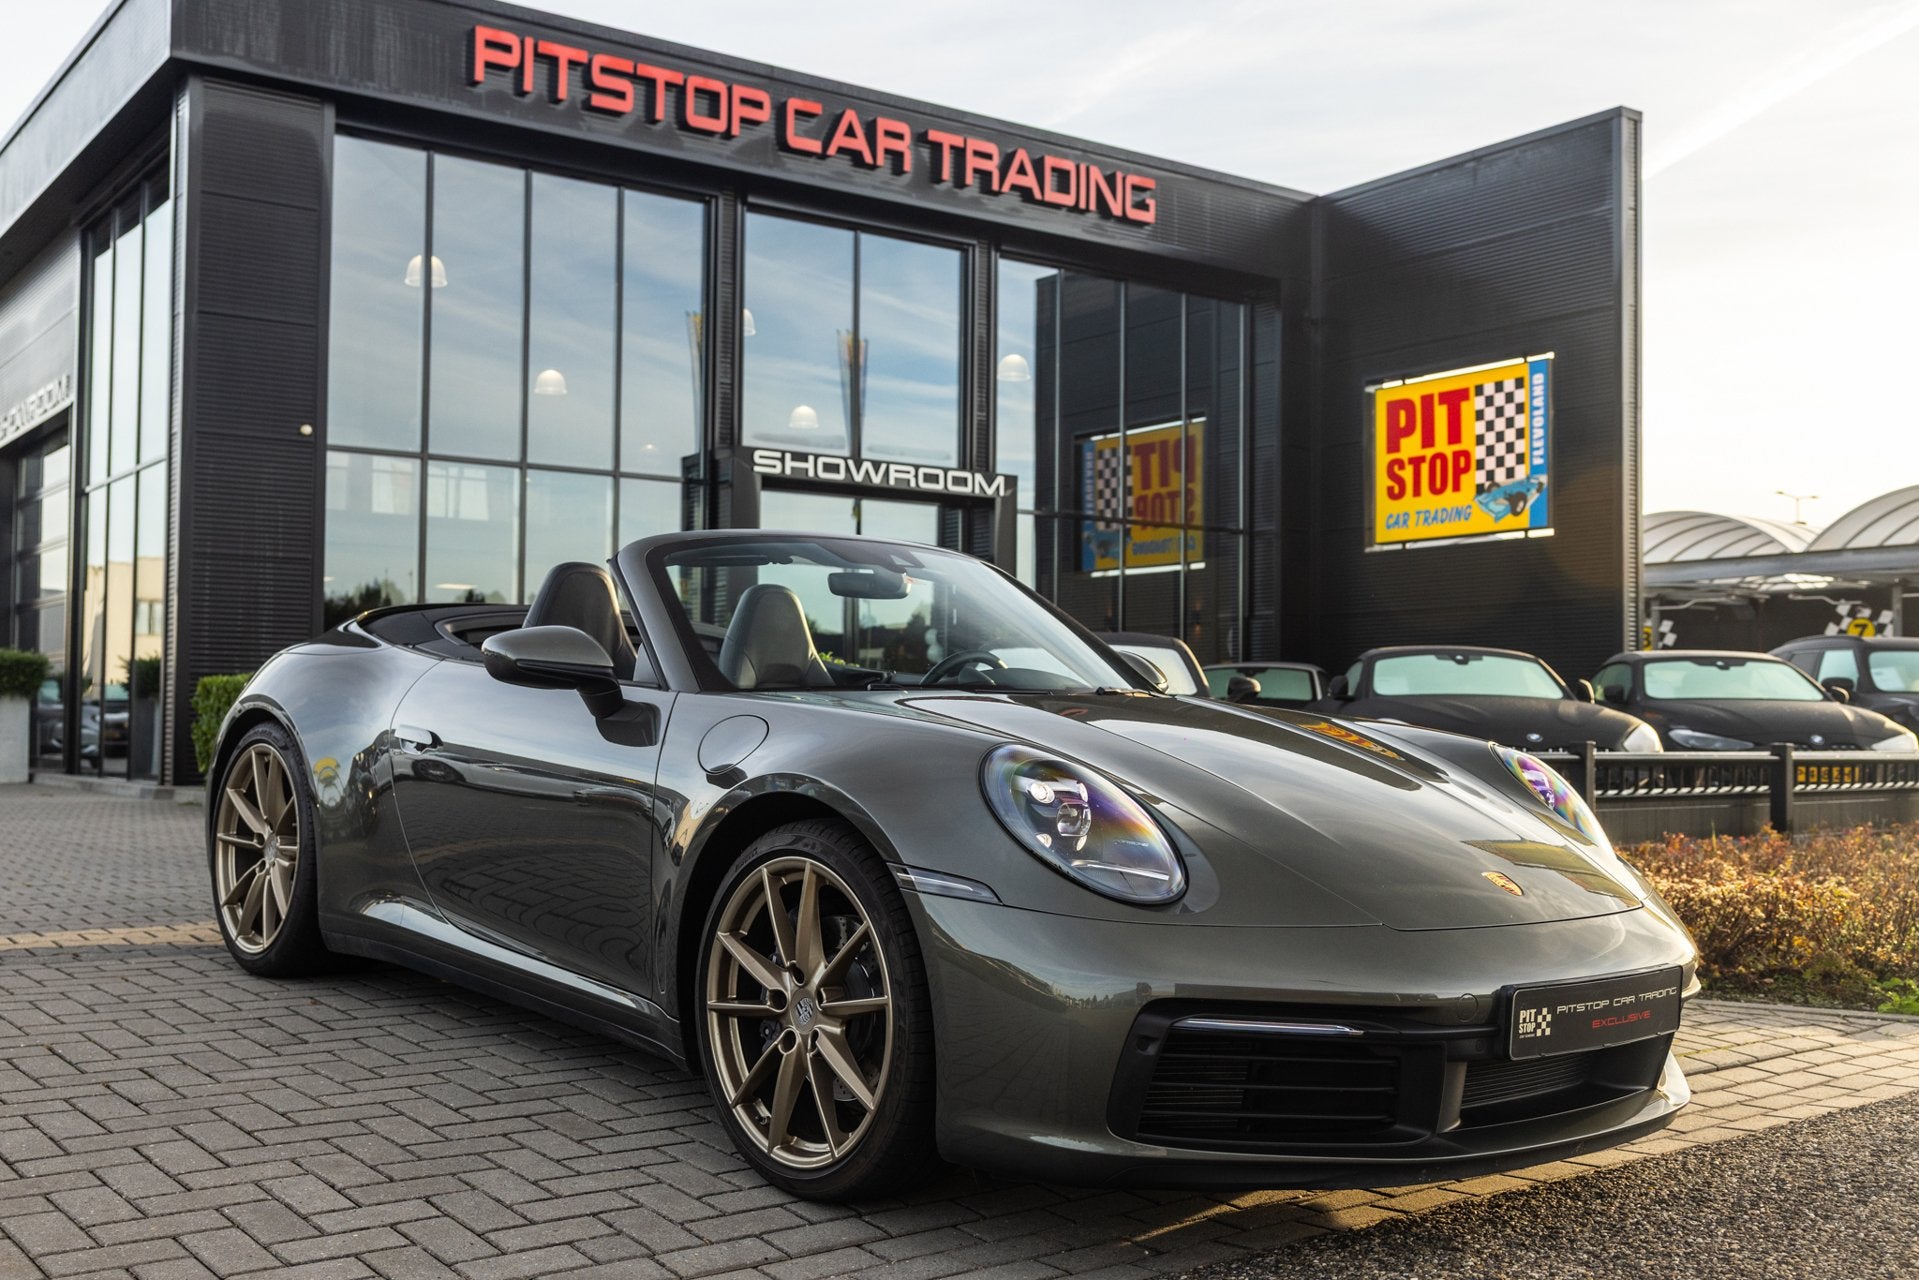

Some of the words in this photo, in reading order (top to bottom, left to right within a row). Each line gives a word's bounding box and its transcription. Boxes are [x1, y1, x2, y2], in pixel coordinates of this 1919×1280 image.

[473, 25, 771, 138] PITSTOP
[785, 98, 912, 173] CAR
[926, 129, 1157, 225] TRADING
[1386, 387, 1471, 454] PIT
[1532, 372, 1545, 466] FLEVOLAND
[753, 449, 1005, 497] SHOWROOM
[1386, 449, 1472, 501] STOP
[1385, 512, 1411, 530] CAR
[1415, 504, 1473, 527] TRADING
[1519, 1008, 1537, 1023] PIT
[1556, 1000, 1610, 1015] PITSTOP
[1613, 995, 1636, 1007] CAR
[1639, 986, 1678, 1002] TRADING
[1591, 1009, 1652, 1029] EXCLUSIVE
[1518, 1021, 1536, 1034] STOP
